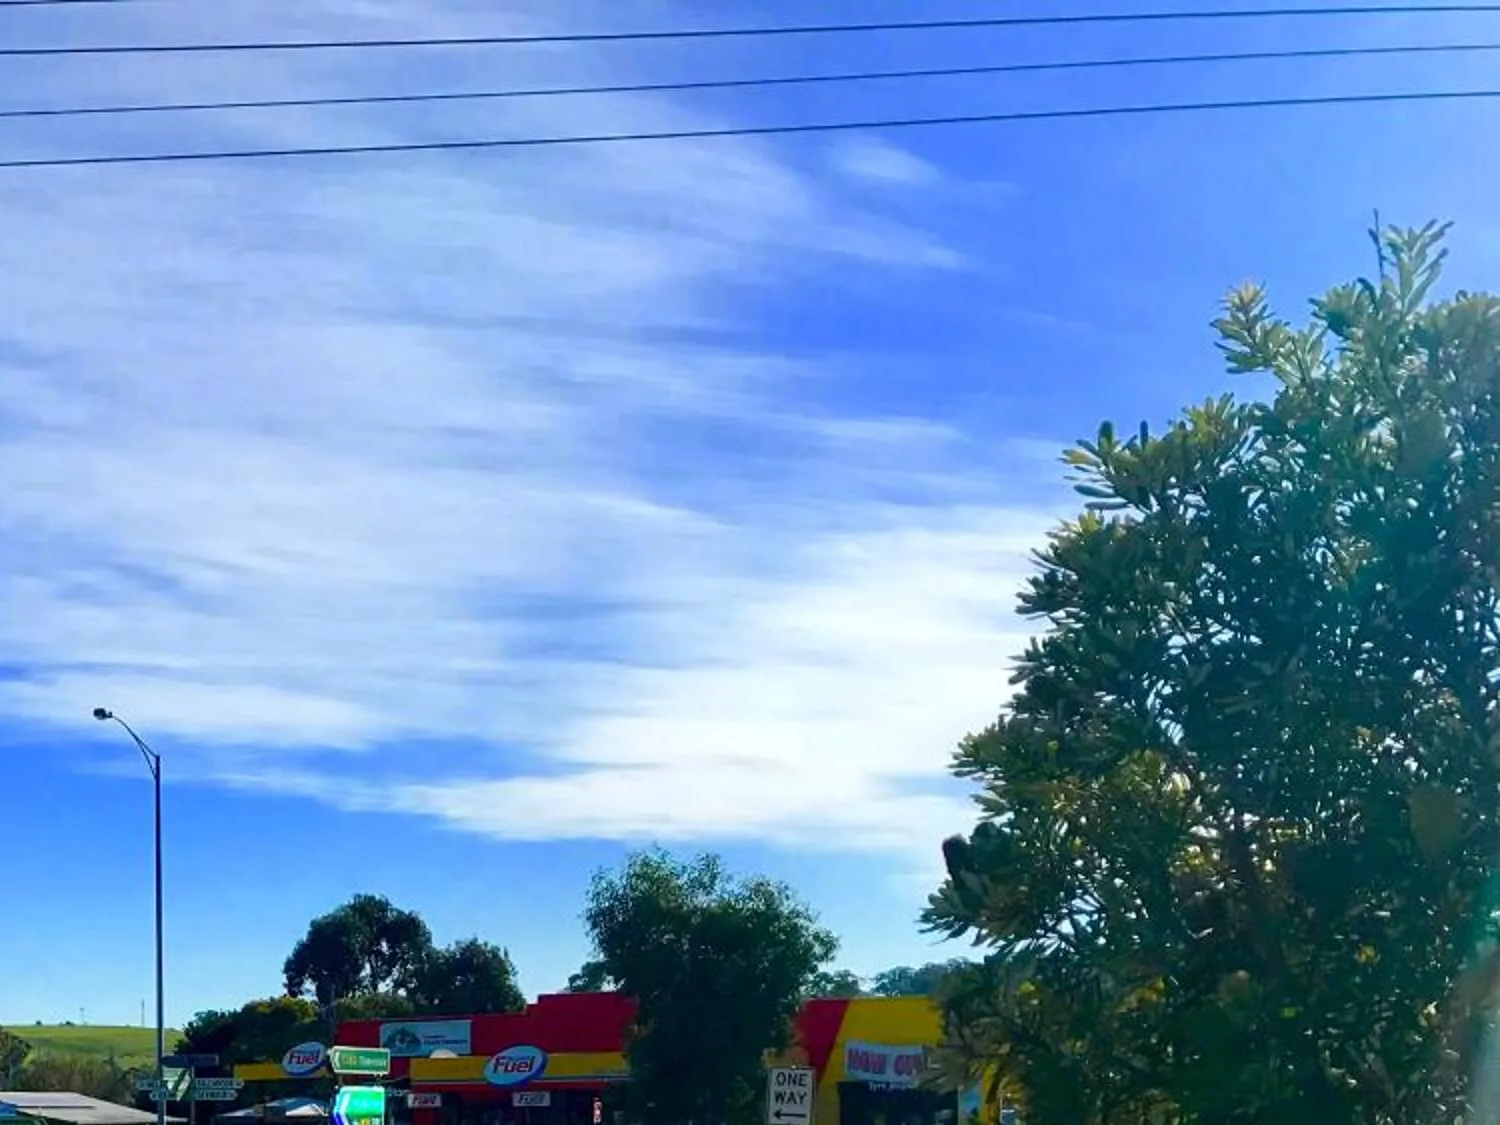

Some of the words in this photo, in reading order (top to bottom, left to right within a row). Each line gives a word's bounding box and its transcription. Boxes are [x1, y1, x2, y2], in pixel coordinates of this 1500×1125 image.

[493, 1055, 536, 1074] Fuel
[775, 1071, 808, 1087] ONE
[774, 1090, 807, 1105] WAY
